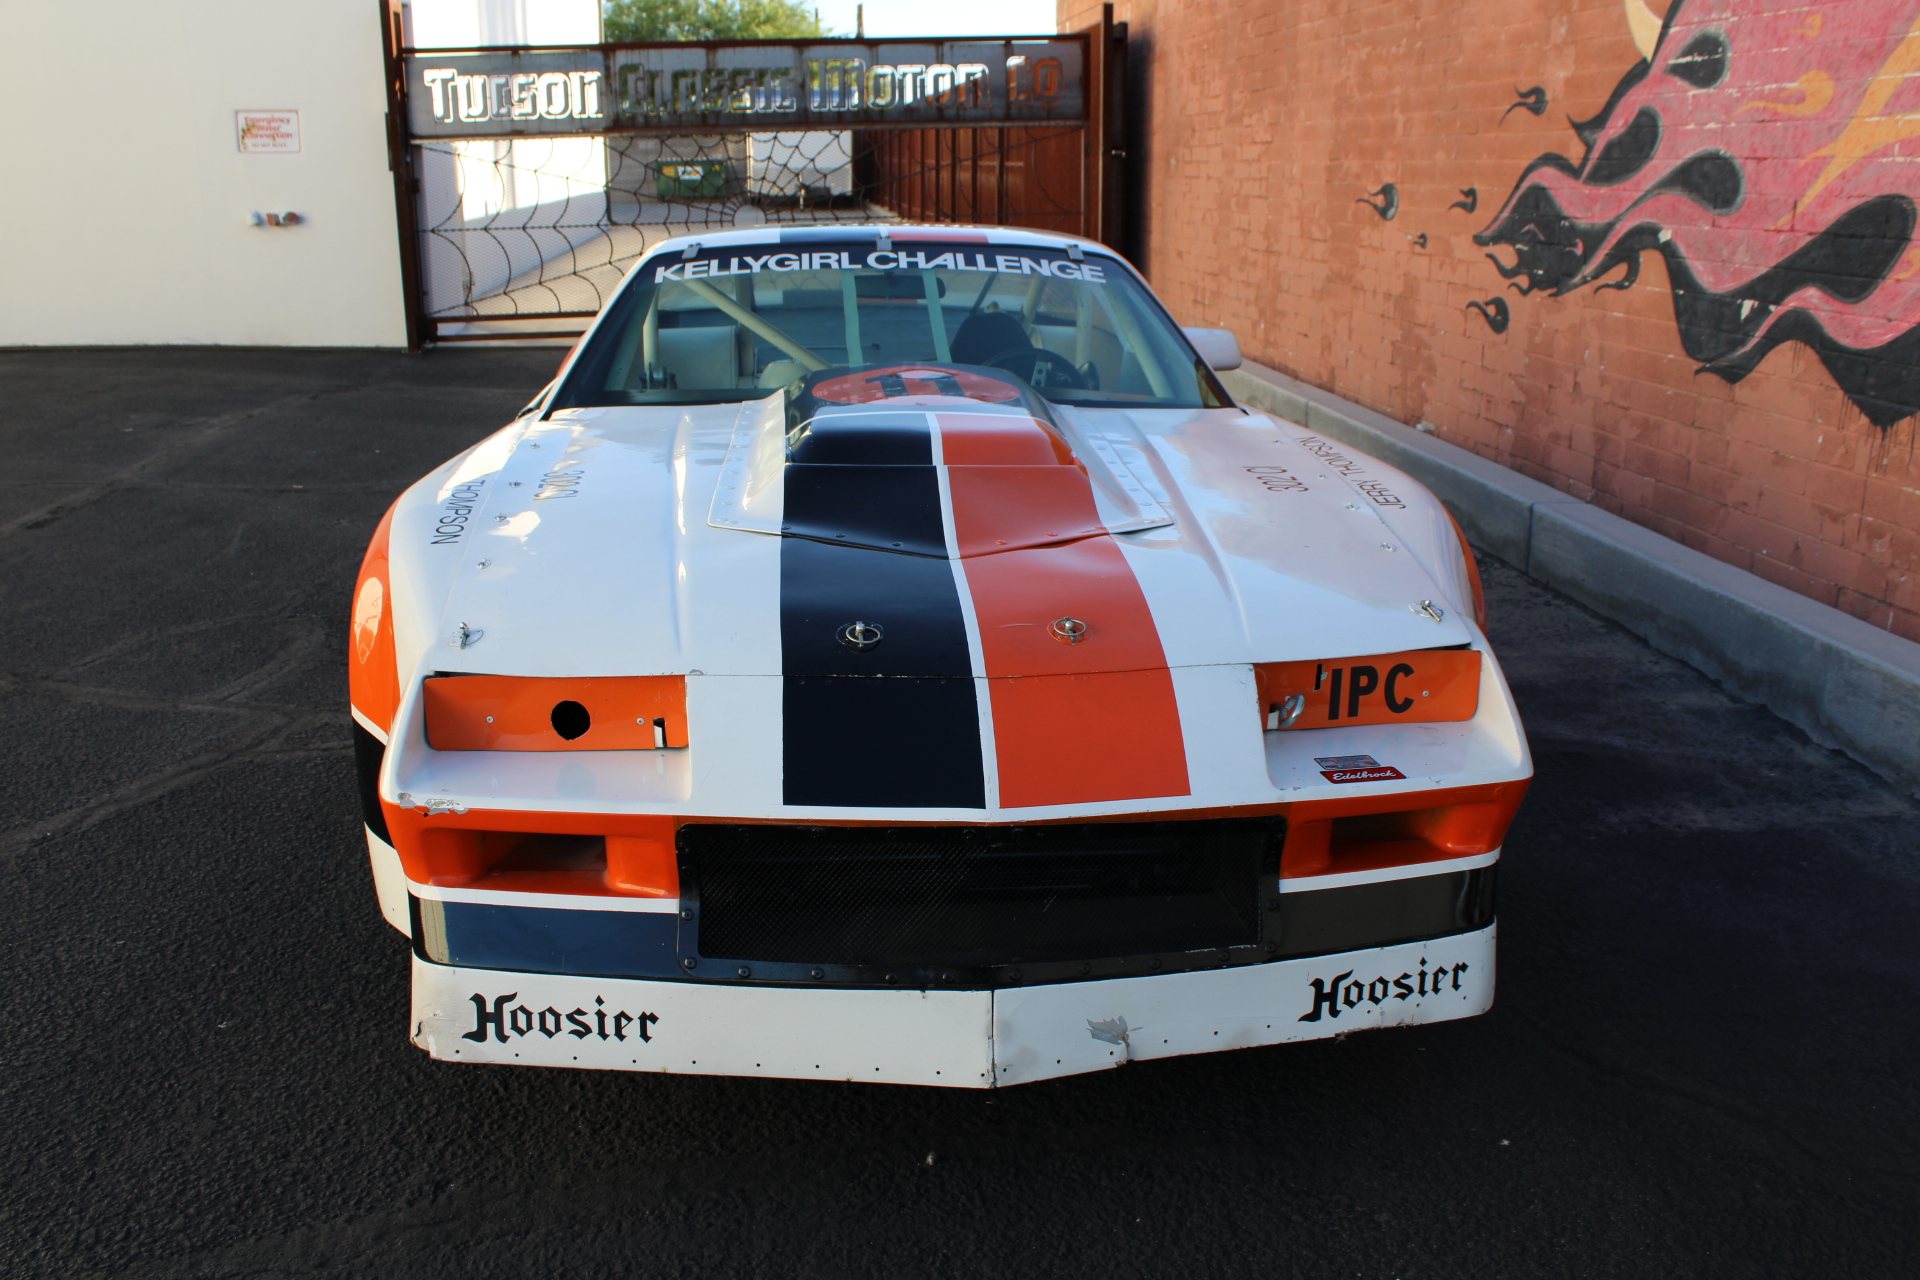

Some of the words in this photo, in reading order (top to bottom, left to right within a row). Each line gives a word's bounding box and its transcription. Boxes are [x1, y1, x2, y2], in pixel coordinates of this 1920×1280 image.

[653, 251, 862, 285] KELLYGIRL
[866, 250, 1108, 285] CHALLENGE
[1295, 436, 1366, 477] THOMPSON
[430, 478, 486, 545] THOMPSON
[1351, 479, 1407, 510] JERRY
[1332, 770, 1397, 781] Edelbrock
[1297, 956, 1469, 1022] Hoosier
[461, 991, 660, 1044] Hoosier
